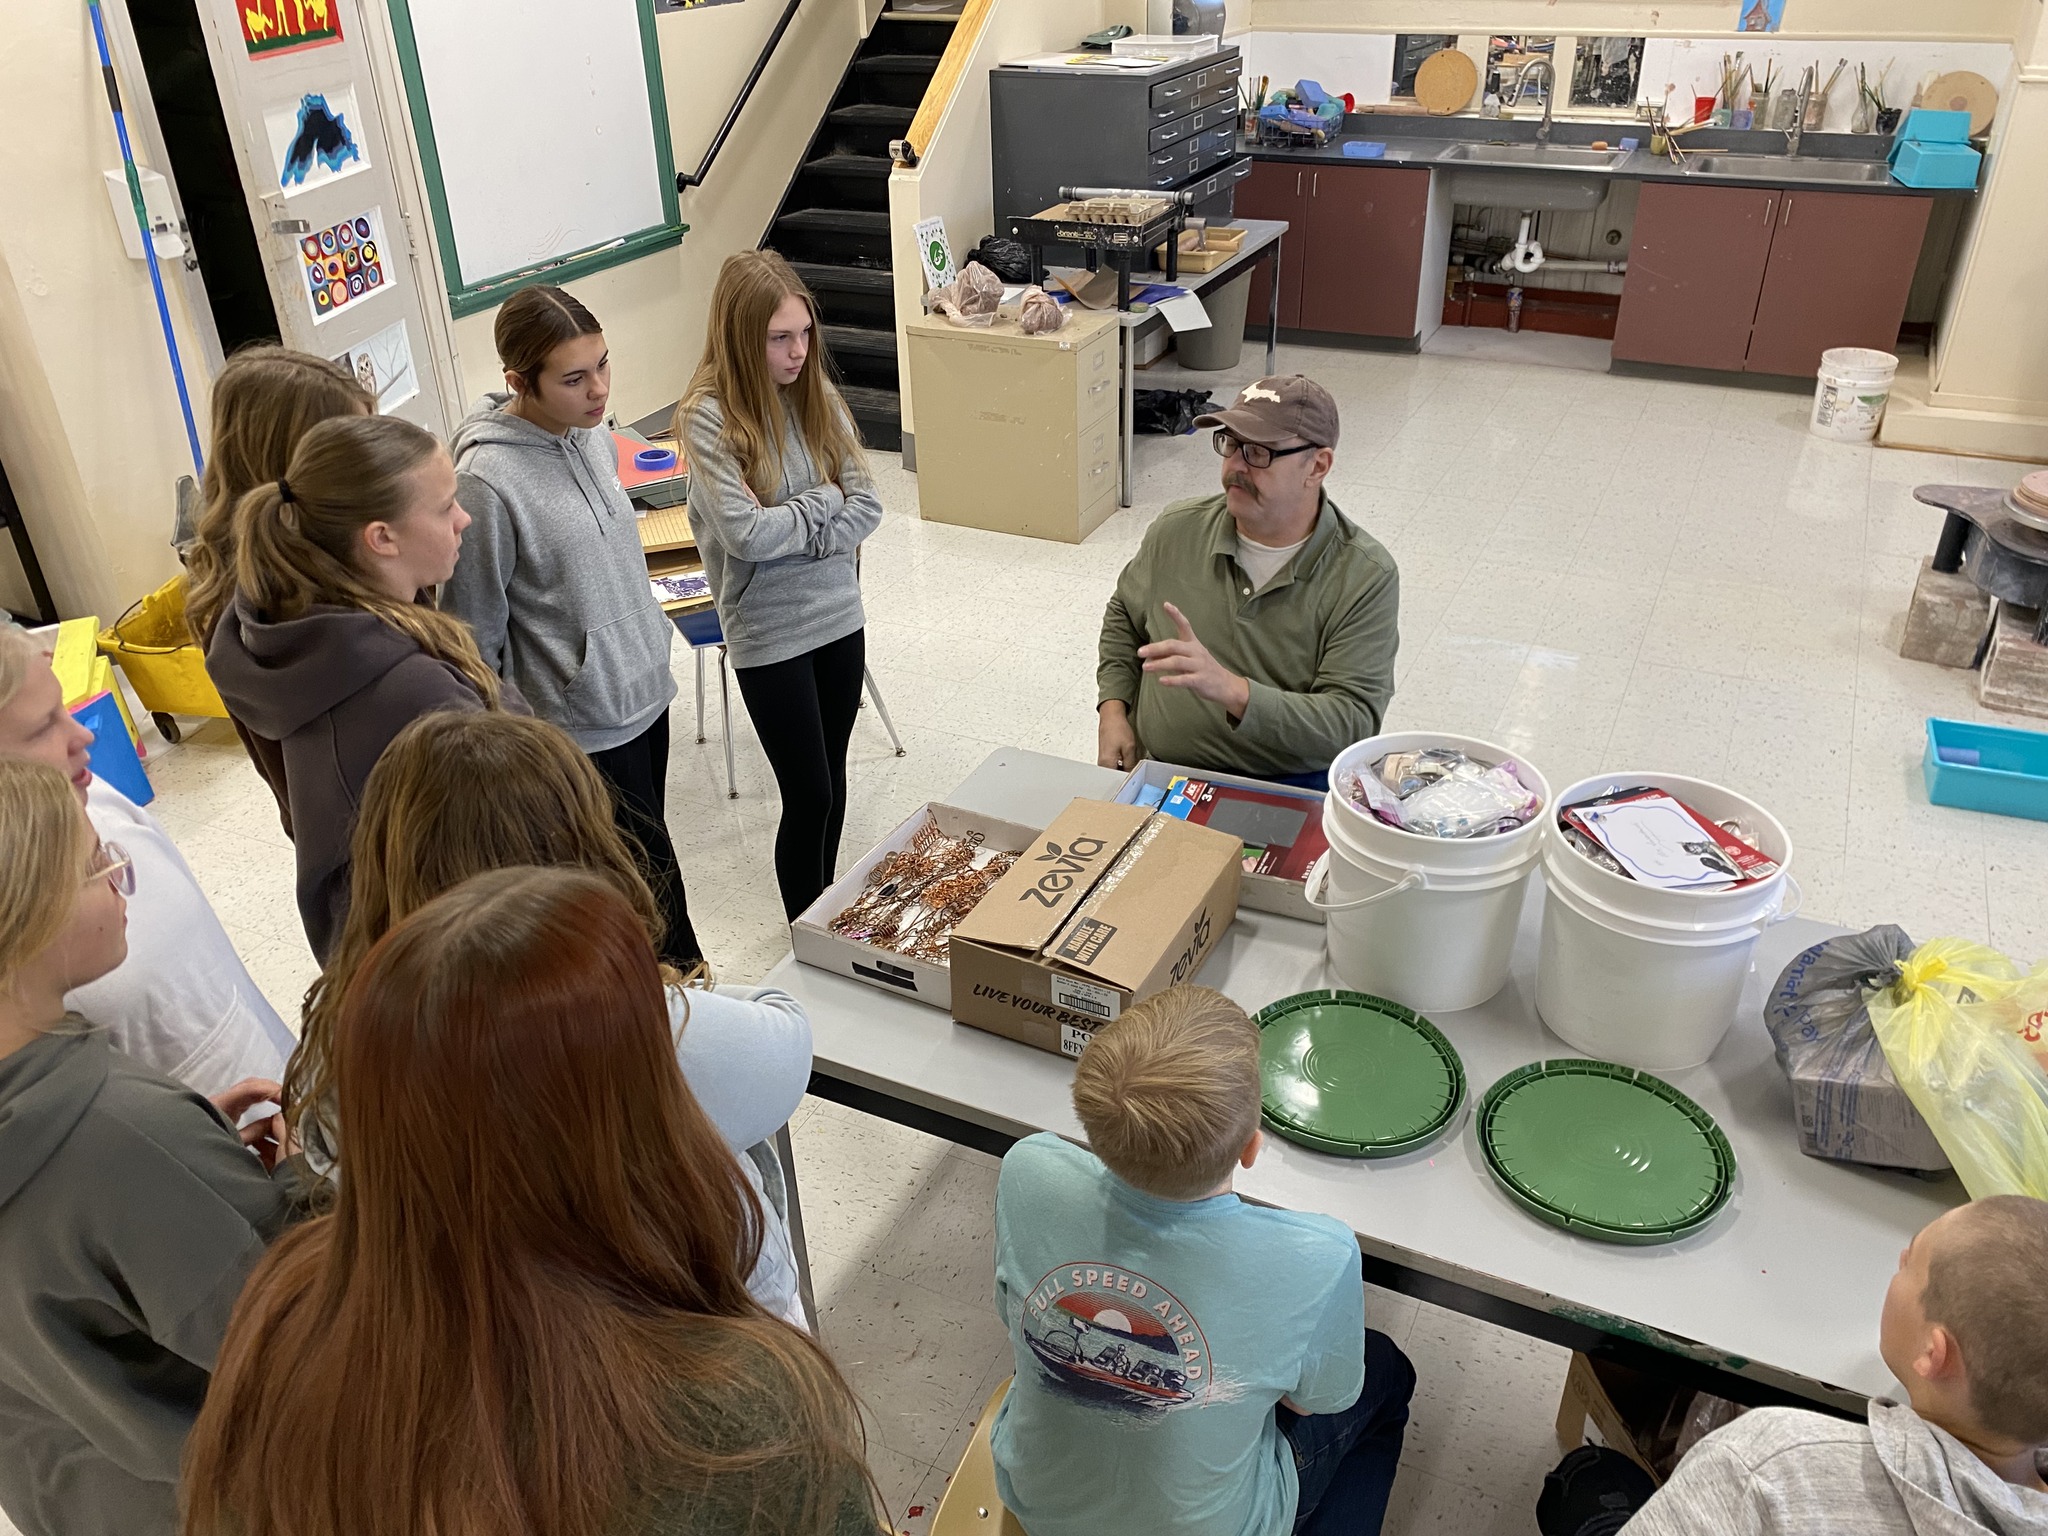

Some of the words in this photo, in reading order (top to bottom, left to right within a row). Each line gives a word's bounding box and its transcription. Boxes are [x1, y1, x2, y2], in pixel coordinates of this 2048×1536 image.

[1201, 793, 1213, 803] 3
[1019, 837, 1108, 908] zevia
[1065, 924, 1095, 952] HANDLE
[1074, 941, 1099, 962] WITH
[1090, 924, 1113, 944] CARE
[973, 983, 1011, 1003] LIVE
[1012, 994, 1057, 1019] YOUR
[1056, 1010, 1104, 1033] BEST
[1029, 1278, 1066, 1321] FULL
[1071, 1269, 1148, 1299] SPEED
[1153, 1300, 1203, 1381] AHEAD
